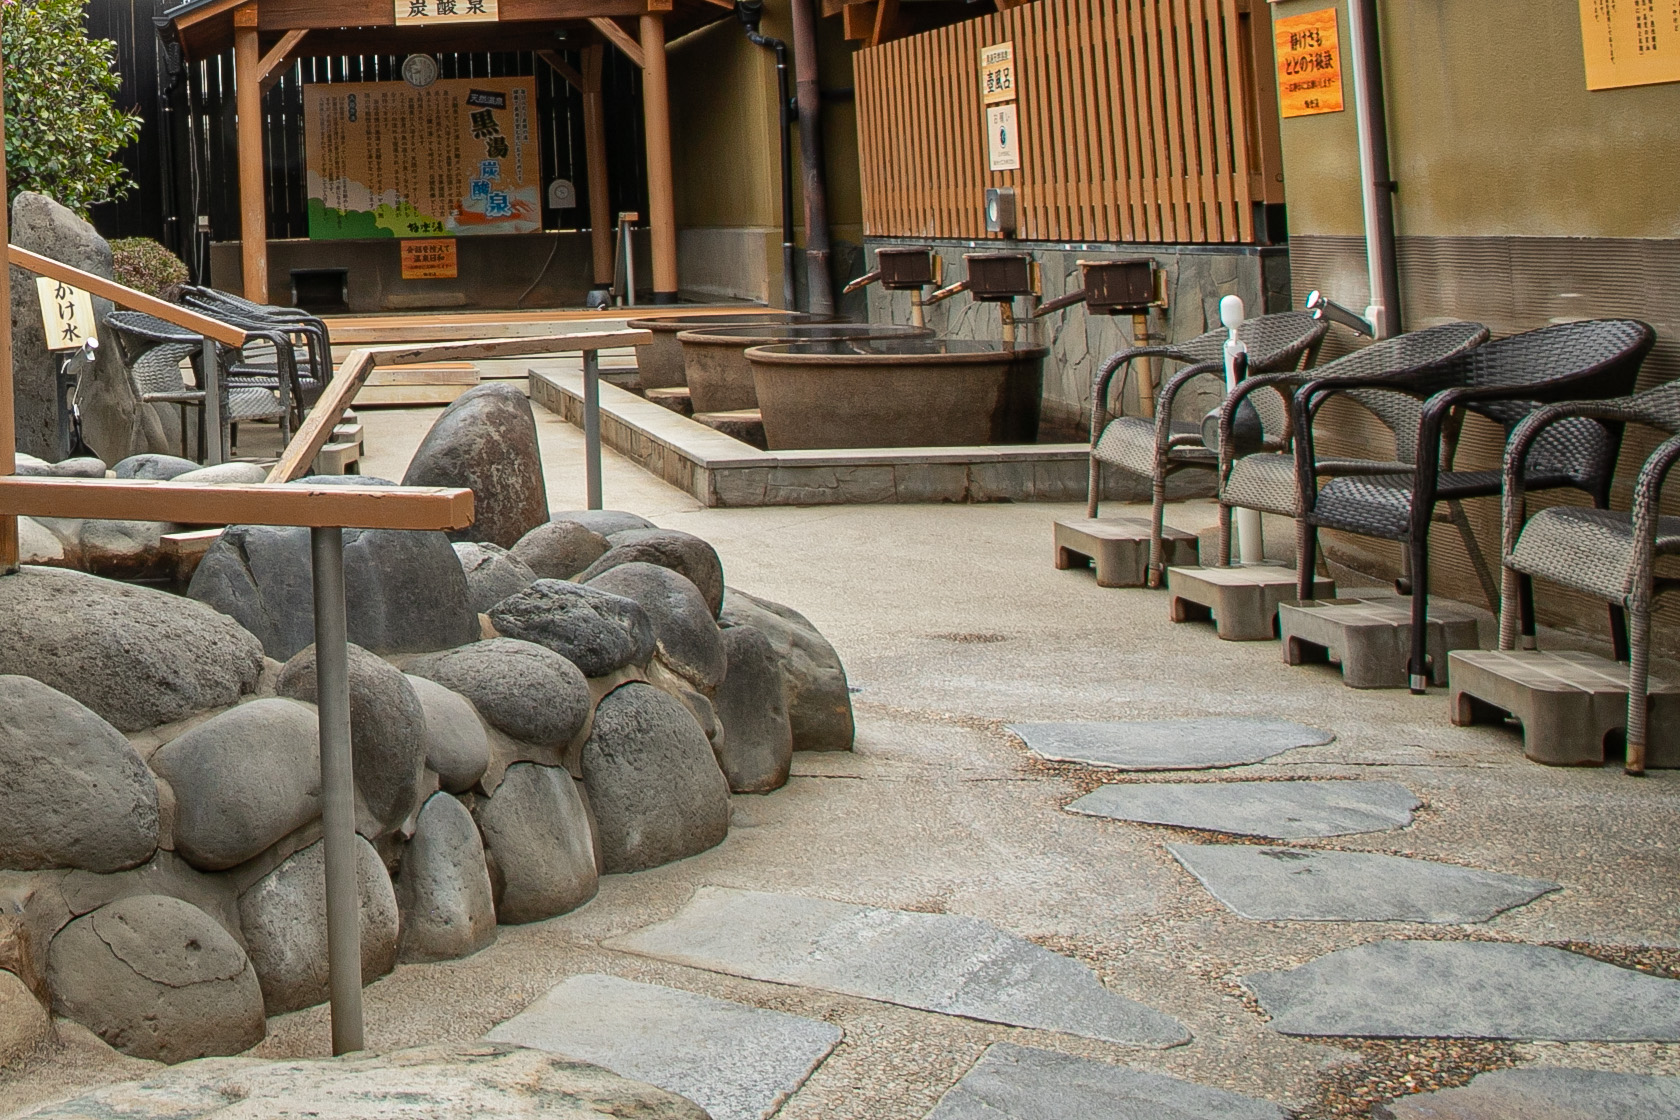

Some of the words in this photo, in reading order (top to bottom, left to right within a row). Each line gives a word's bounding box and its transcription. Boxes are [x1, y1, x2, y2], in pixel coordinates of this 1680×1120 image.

[469, 93, 504, 106] 天然温泉
[470, 108, 510, 159] 黒湯
[470, 159, 512, 217] 炭酸泉
[54, 281, 81, 343] かけ水
